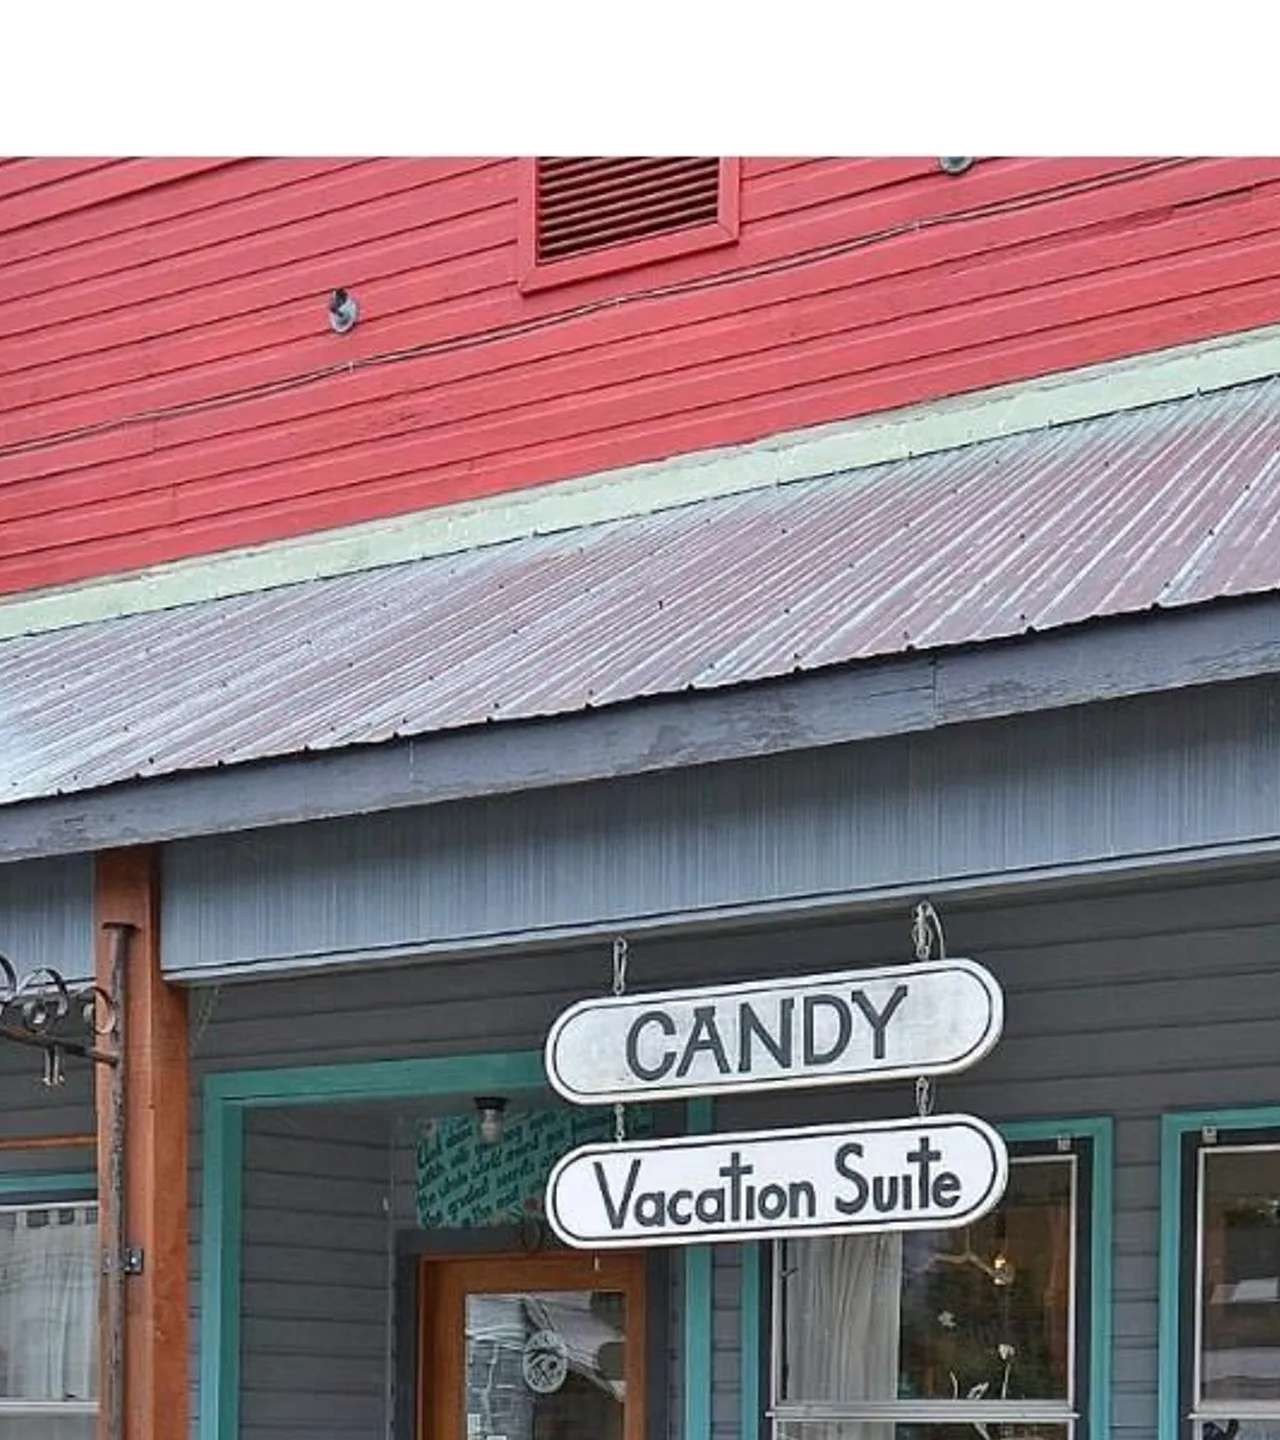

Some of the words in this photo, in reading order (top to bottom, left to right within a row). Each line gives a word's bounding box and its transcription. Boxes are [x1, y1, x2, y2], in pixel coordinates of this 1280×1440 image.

[625, 985, 909, 1081] CANDY
[593, 1152, 816, 1230] Vacation
[834, 1136, 962, 1215] Suite
